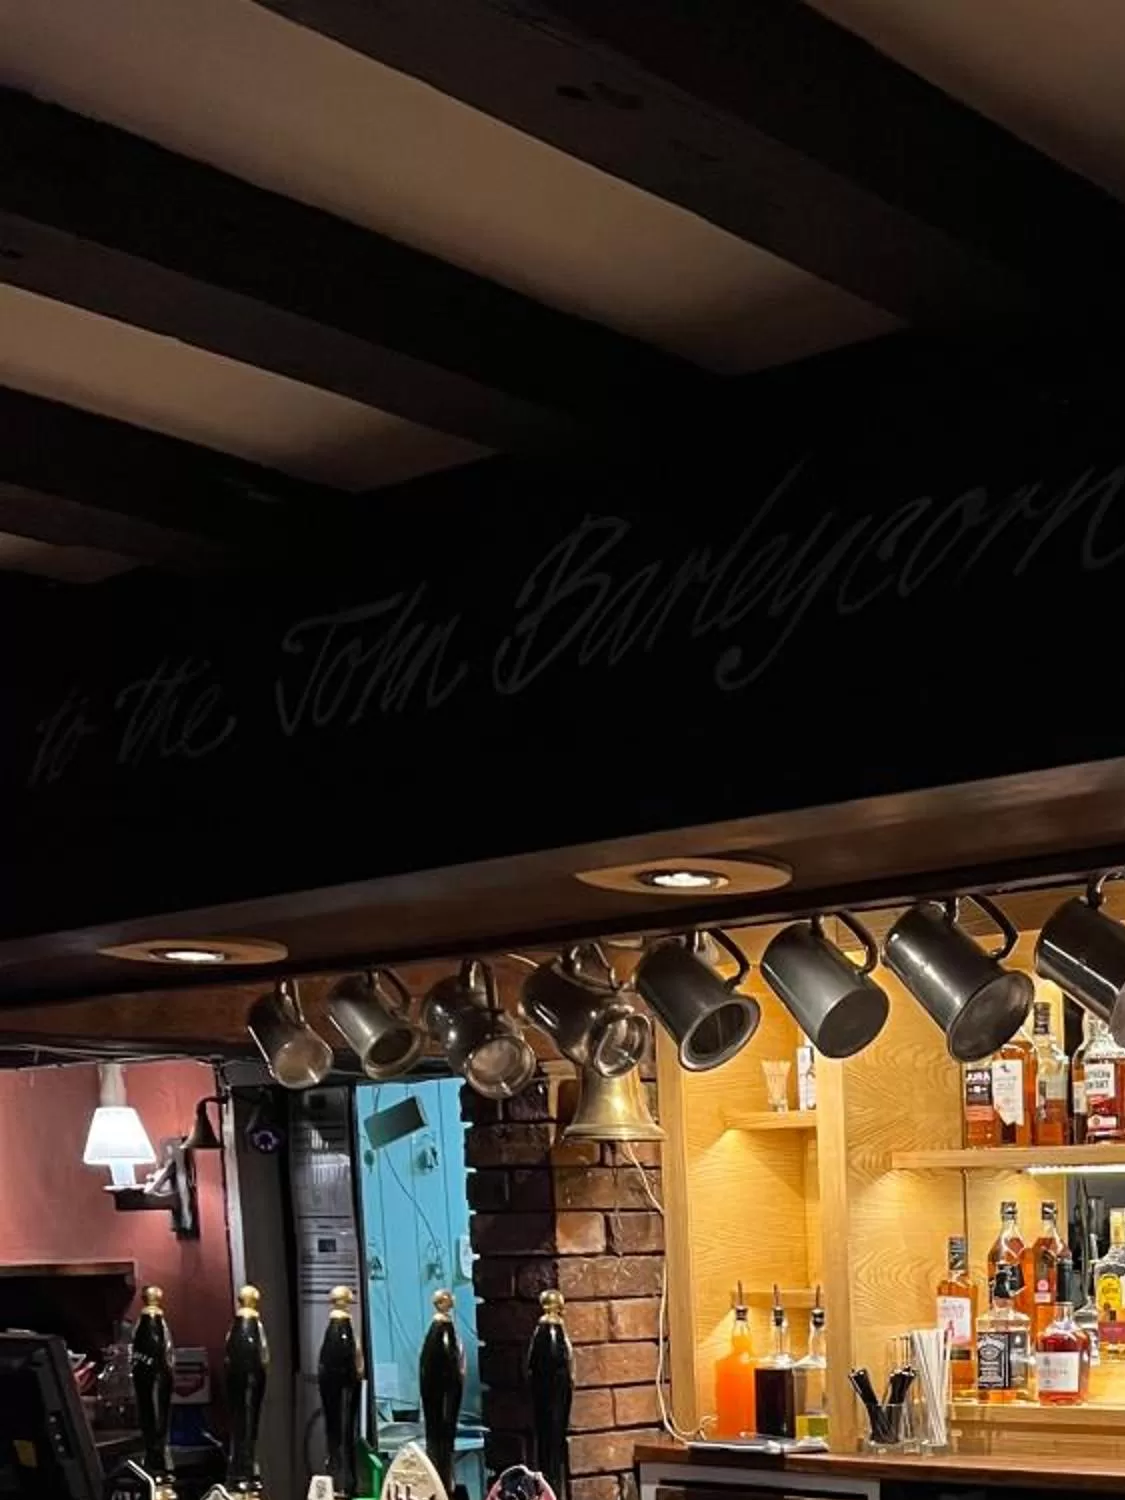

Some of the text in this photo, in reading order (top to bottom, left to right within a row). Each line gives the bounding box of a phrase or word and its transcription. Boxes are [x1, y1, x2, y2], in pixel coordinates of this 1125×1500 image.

[26, 680, 99, 788] to
[114, 655, 238, 767] the
[275, 581, 469, 736] John
